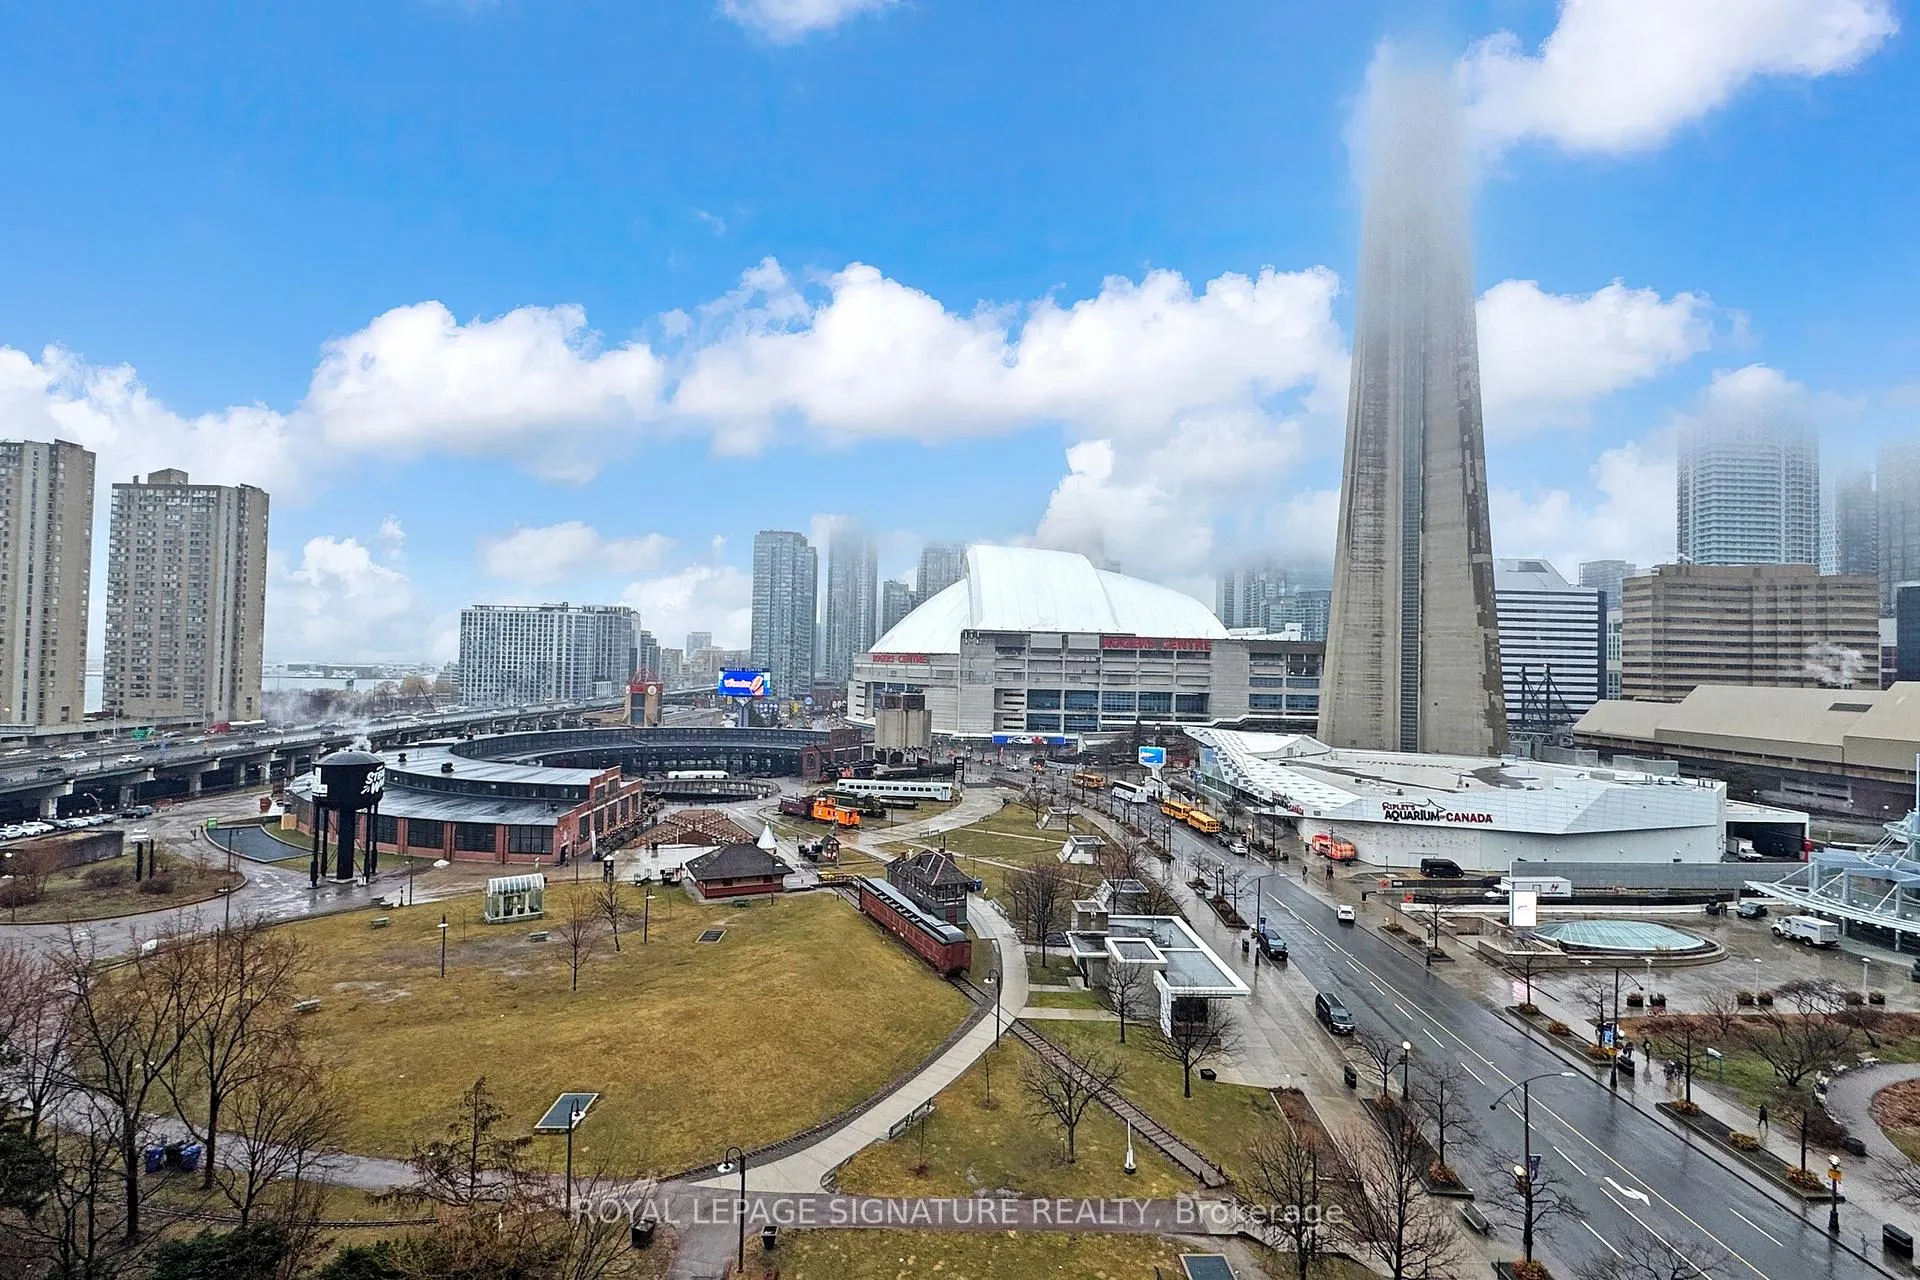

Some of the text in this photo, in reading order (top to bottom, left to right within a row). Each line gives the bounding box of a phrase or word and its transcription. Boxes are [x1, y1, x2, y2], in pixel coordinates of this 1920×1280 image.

[1103, 636, 1211, 650] ROGERS CENTRE
[872, 654, 927, 664] ROGERS CENTRE
[1384, 809, 1440, 821] AQUARIUM
[1446, 812, 1493, 823] CANADA
